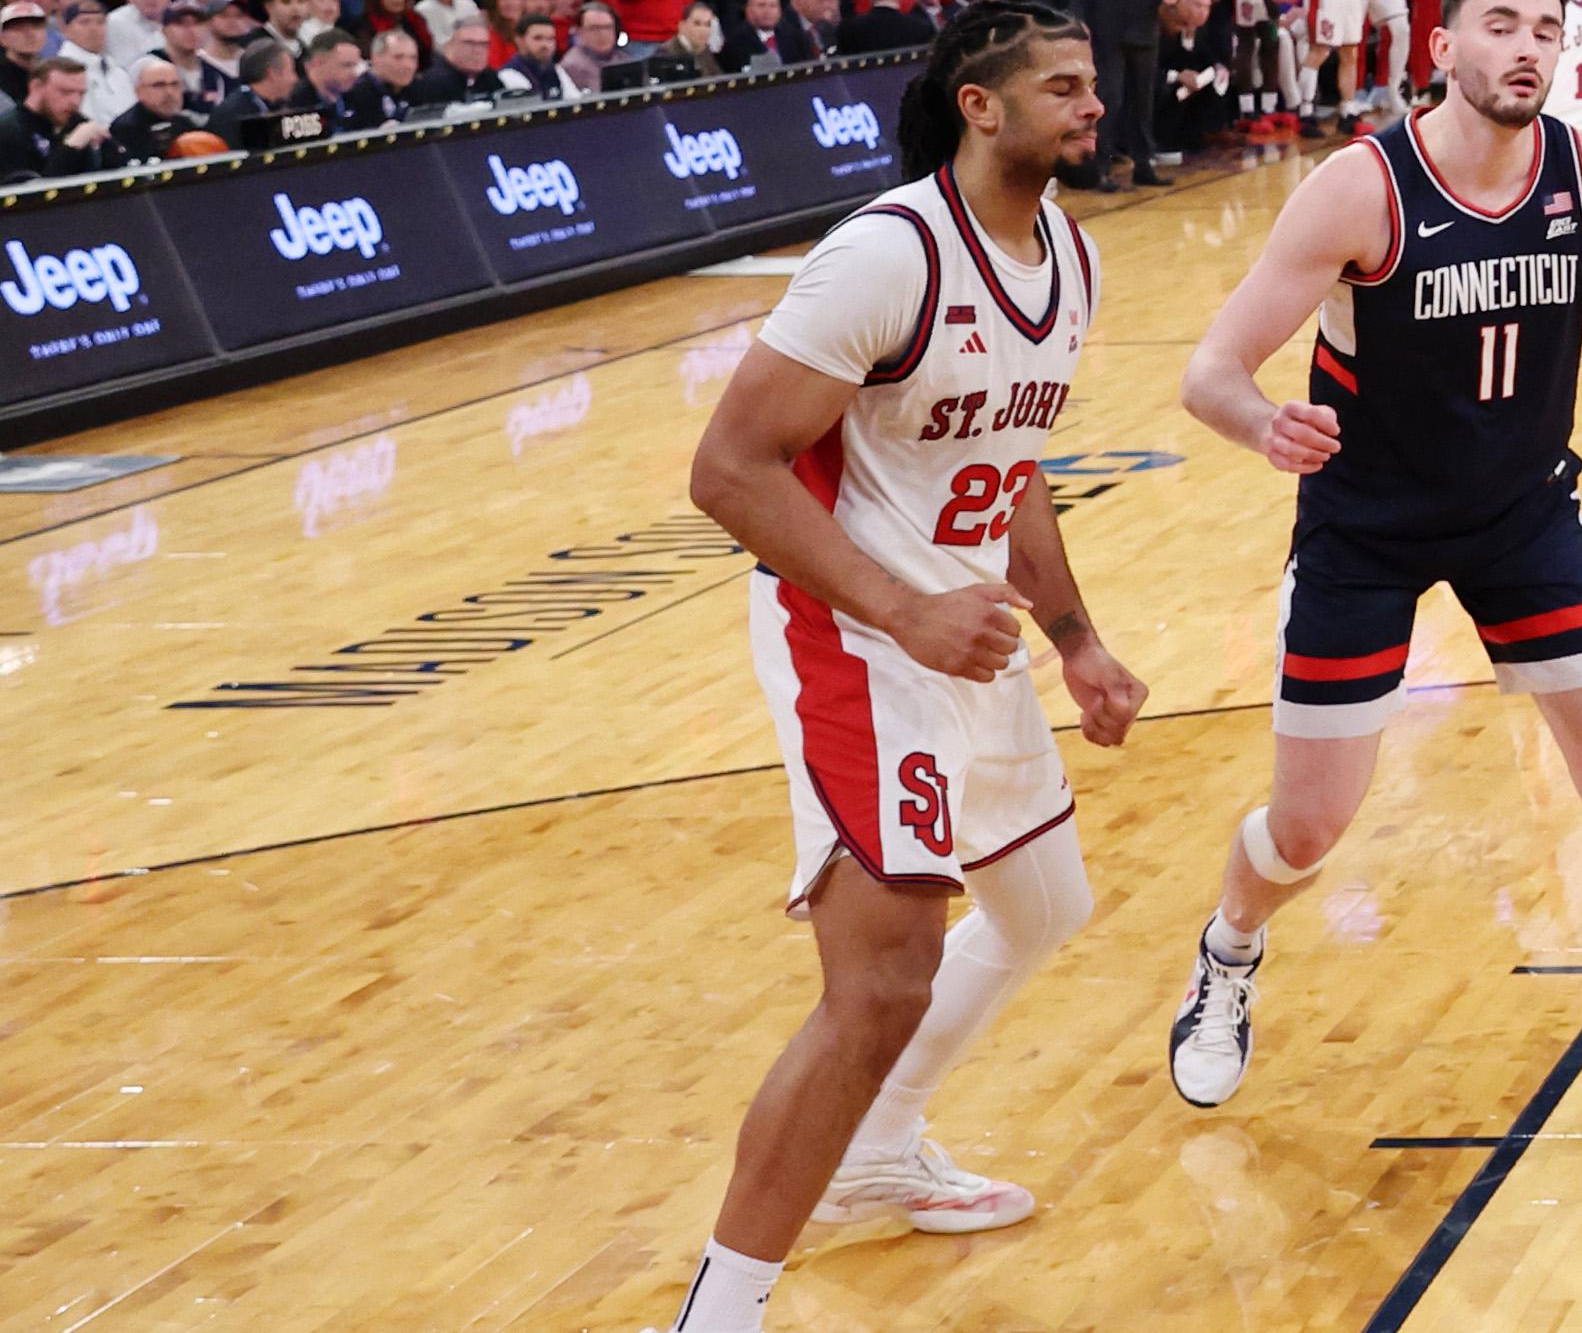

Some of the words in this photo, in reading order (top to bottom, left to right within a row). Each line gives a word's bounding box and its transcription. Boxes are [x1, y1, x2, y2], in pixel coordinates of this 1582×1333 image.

[663, 123, 744, 180] Jeep
[812, 96, 879, 150] Jeep
[486, 153, 580, 216] Jeep
[270, 193, 384, 261] Jeep
[1, 239, 141, 315] Jeep
[1413, 253, 1580, 321] CONNECTICUT
[1479, 322, 1520, 402] 11
[918, 390, 988, 441] ST.
[932, 459, 1038, 547] 23
[168, 569, 701, 710] MADISON
